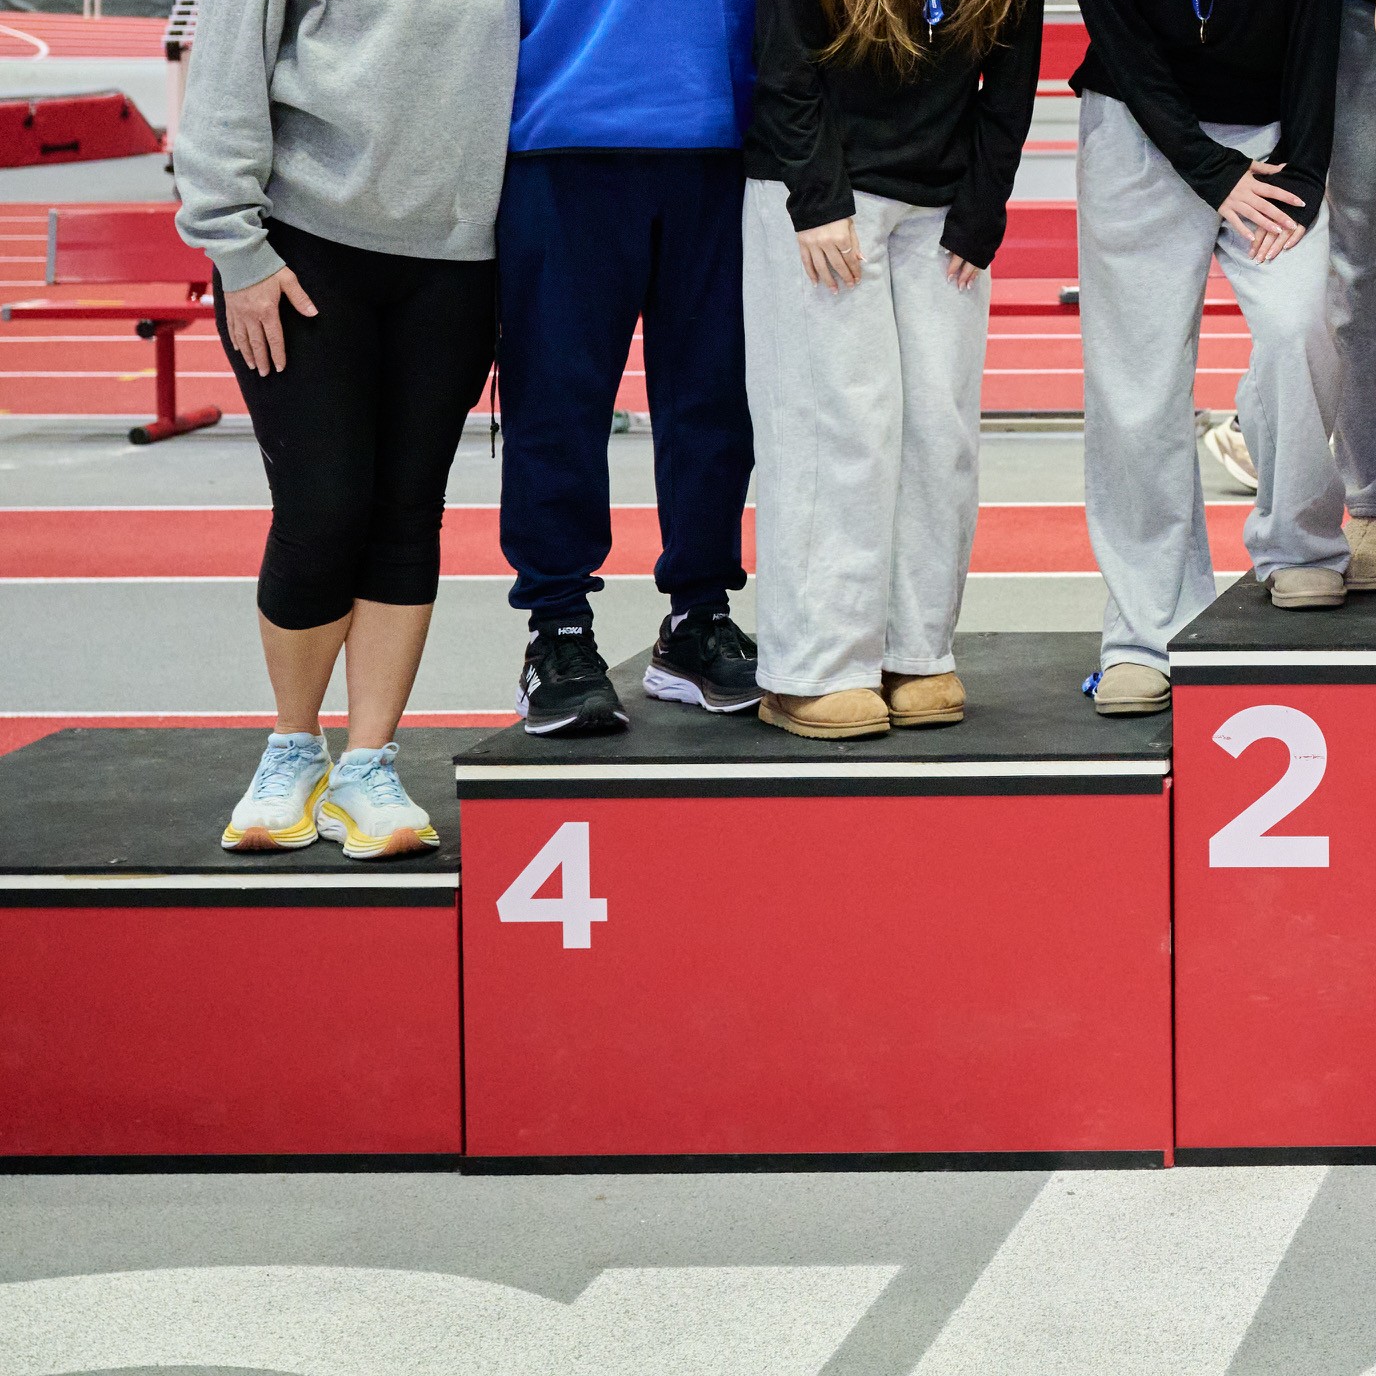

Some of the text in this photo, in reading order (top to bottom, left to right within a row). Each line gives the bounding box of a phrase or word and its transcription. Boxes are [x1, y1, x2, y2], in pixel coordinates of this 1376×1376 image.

[558, 626, 583, 635] HOKA
[1209, 705, 1330, 868] 2
[495, 822, 608, 949] 4
